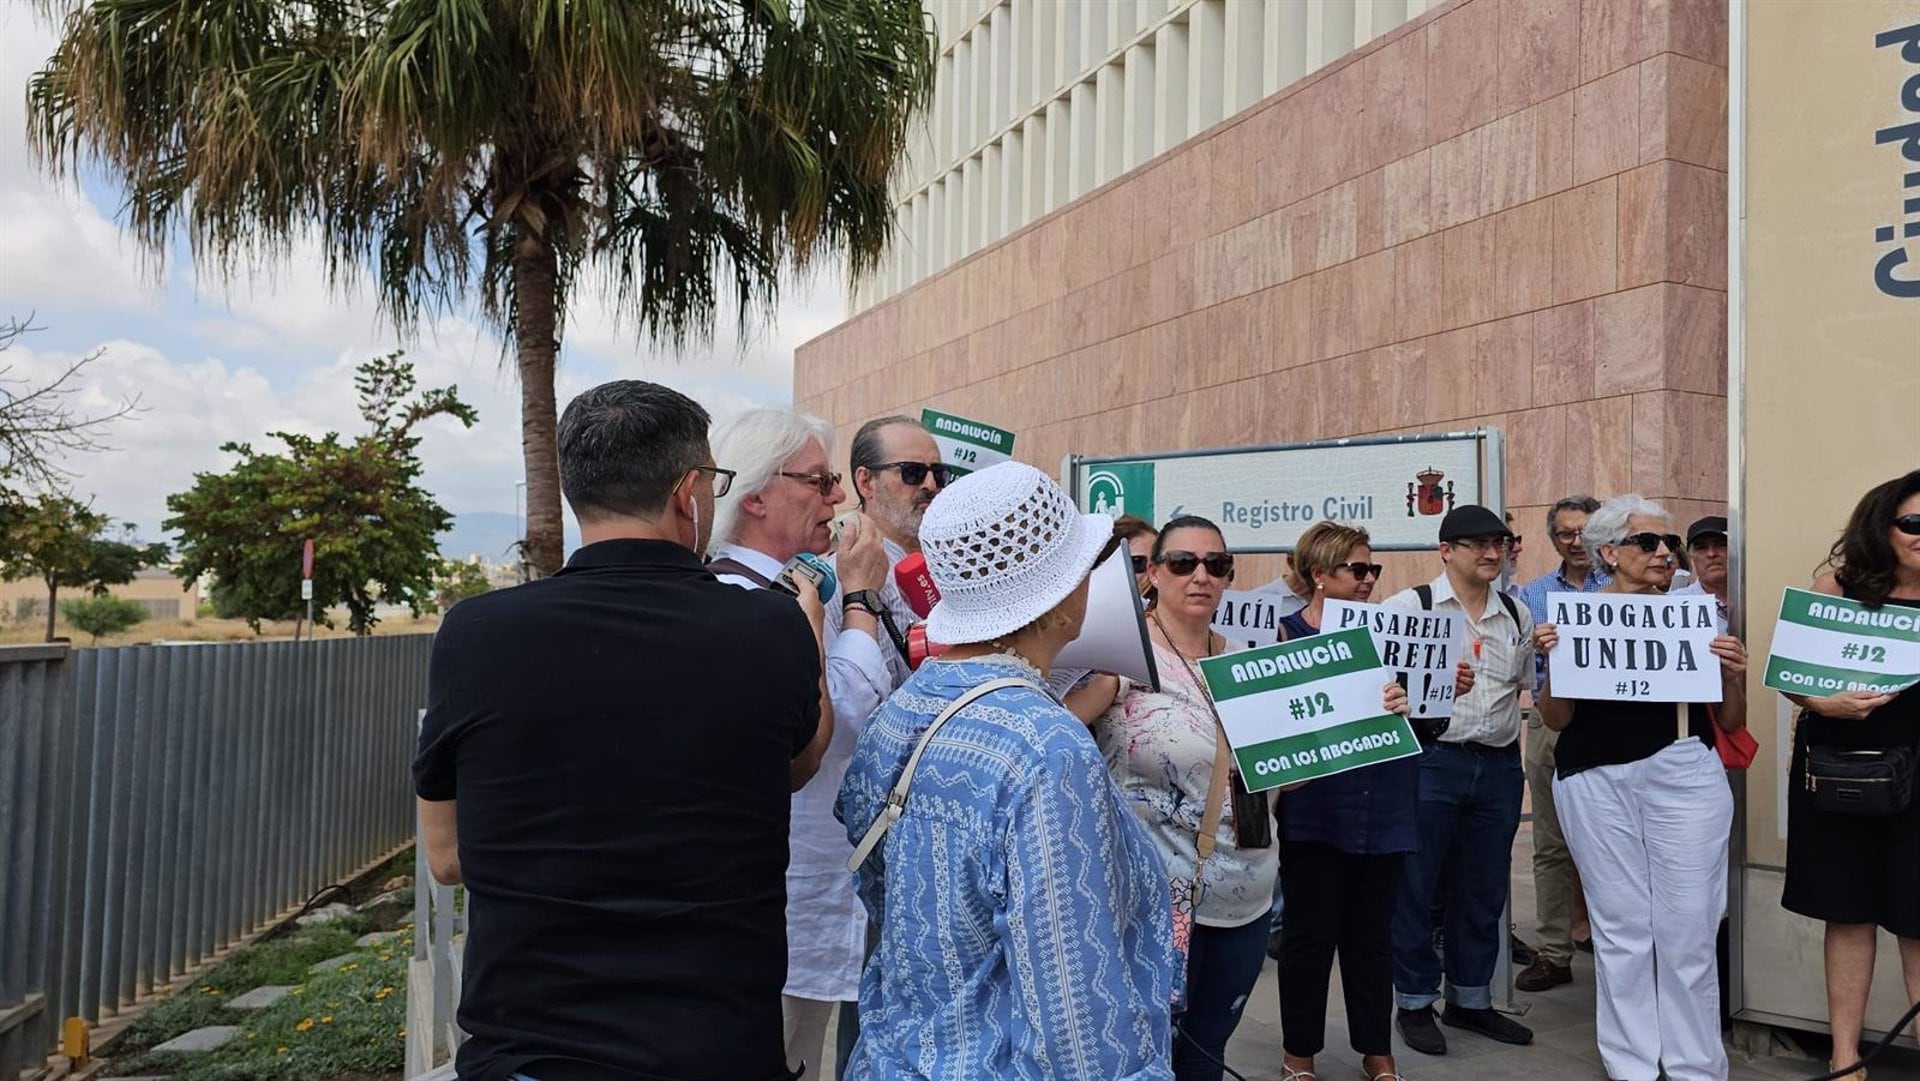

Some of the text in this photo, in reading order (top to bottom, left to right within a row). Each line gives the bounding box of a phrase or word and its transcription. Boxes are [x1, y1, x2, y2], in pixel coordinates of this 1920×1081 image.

[935, 417, 1002, 445] ANDALUCÍA
[953, 446, 977, 462] #J2
[1222, 496, 1373, 529] Registro Civil
[1340, 607, 1451, 638] PASARELA
[1556, 601, 1712, 629] ABOGACÍA
[1231, 639, 1353, 683] ANDALUCÍA
[1573, 637, 1697, 671] UNIDA
[1841, 643, 1887, 662] #J2
[1429, 685, 1453, 701] #J2
[1615, 681, 1650, 697] #J2
[1779, 670, 1814, 686] CON
[1818, 677, 1845, 690] LOS
[1288, 692, 1334, 720] #J2
[1254, 730, 1400, 775] CON LOS ABOGADOS
